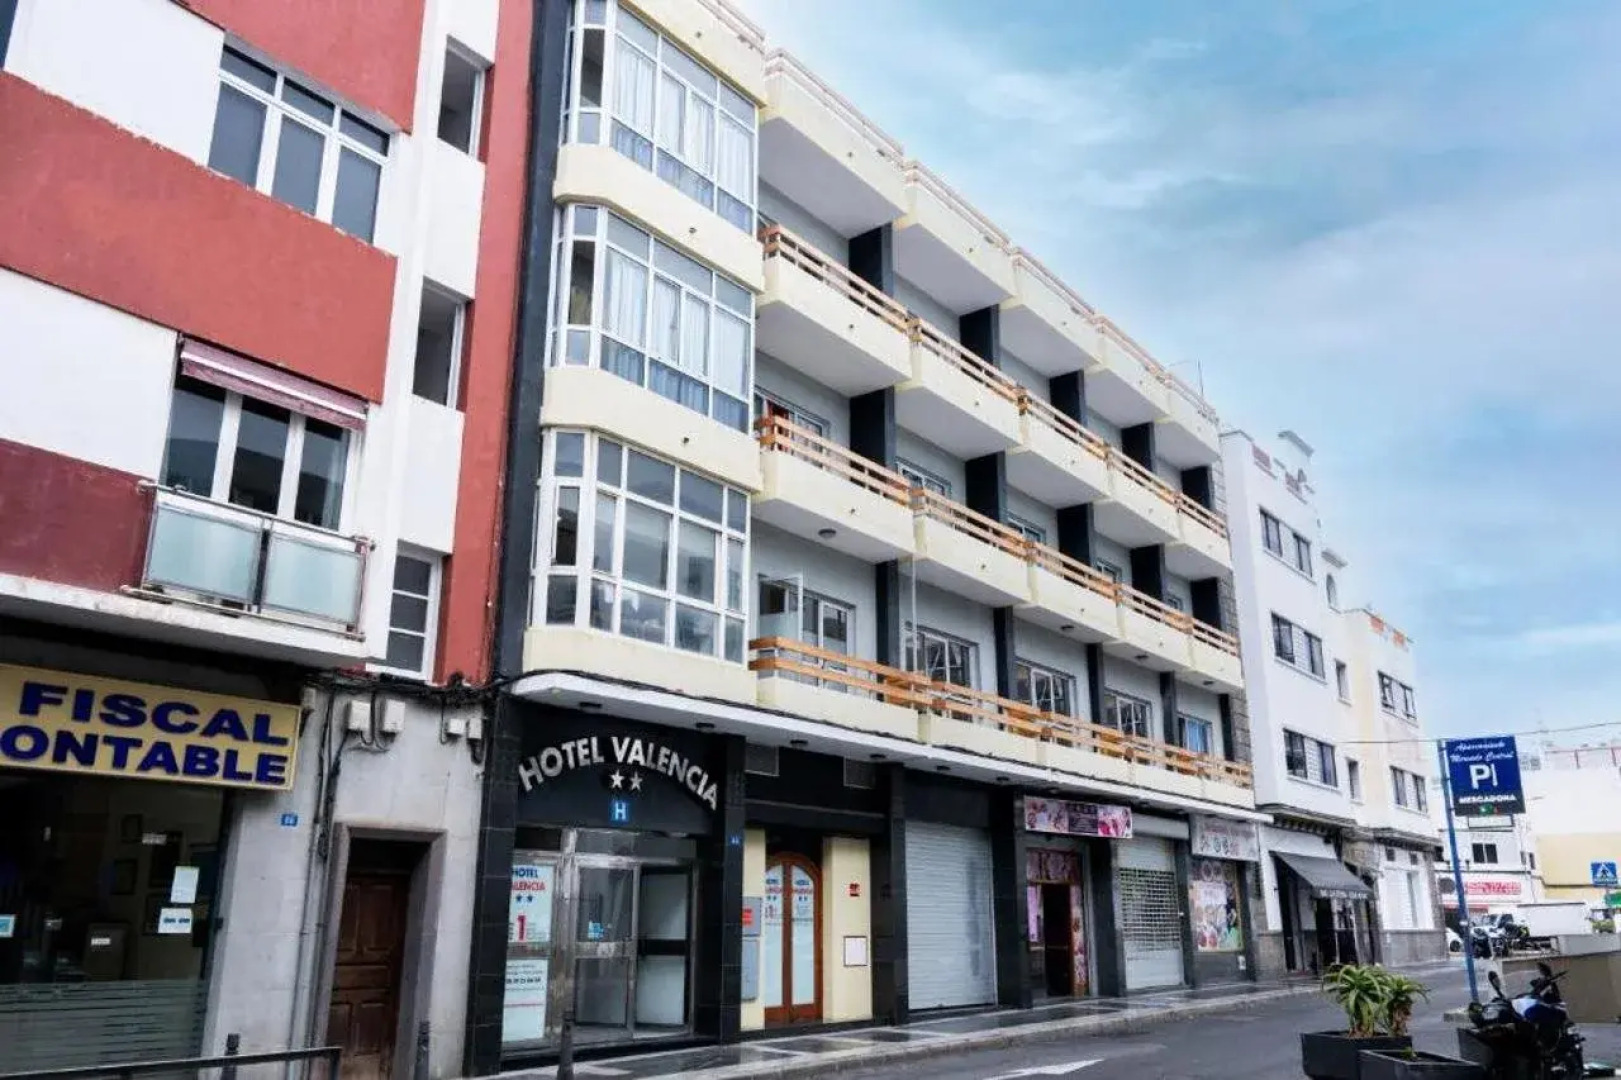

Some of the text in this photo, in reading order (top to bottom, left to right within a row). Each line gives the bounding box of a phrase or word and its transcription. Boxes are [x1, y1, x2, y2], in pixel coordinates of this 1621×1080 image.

[19, 680, 290, 747] FISCAL
[518, 736, 718, 811] HOTEL VALENCIA
